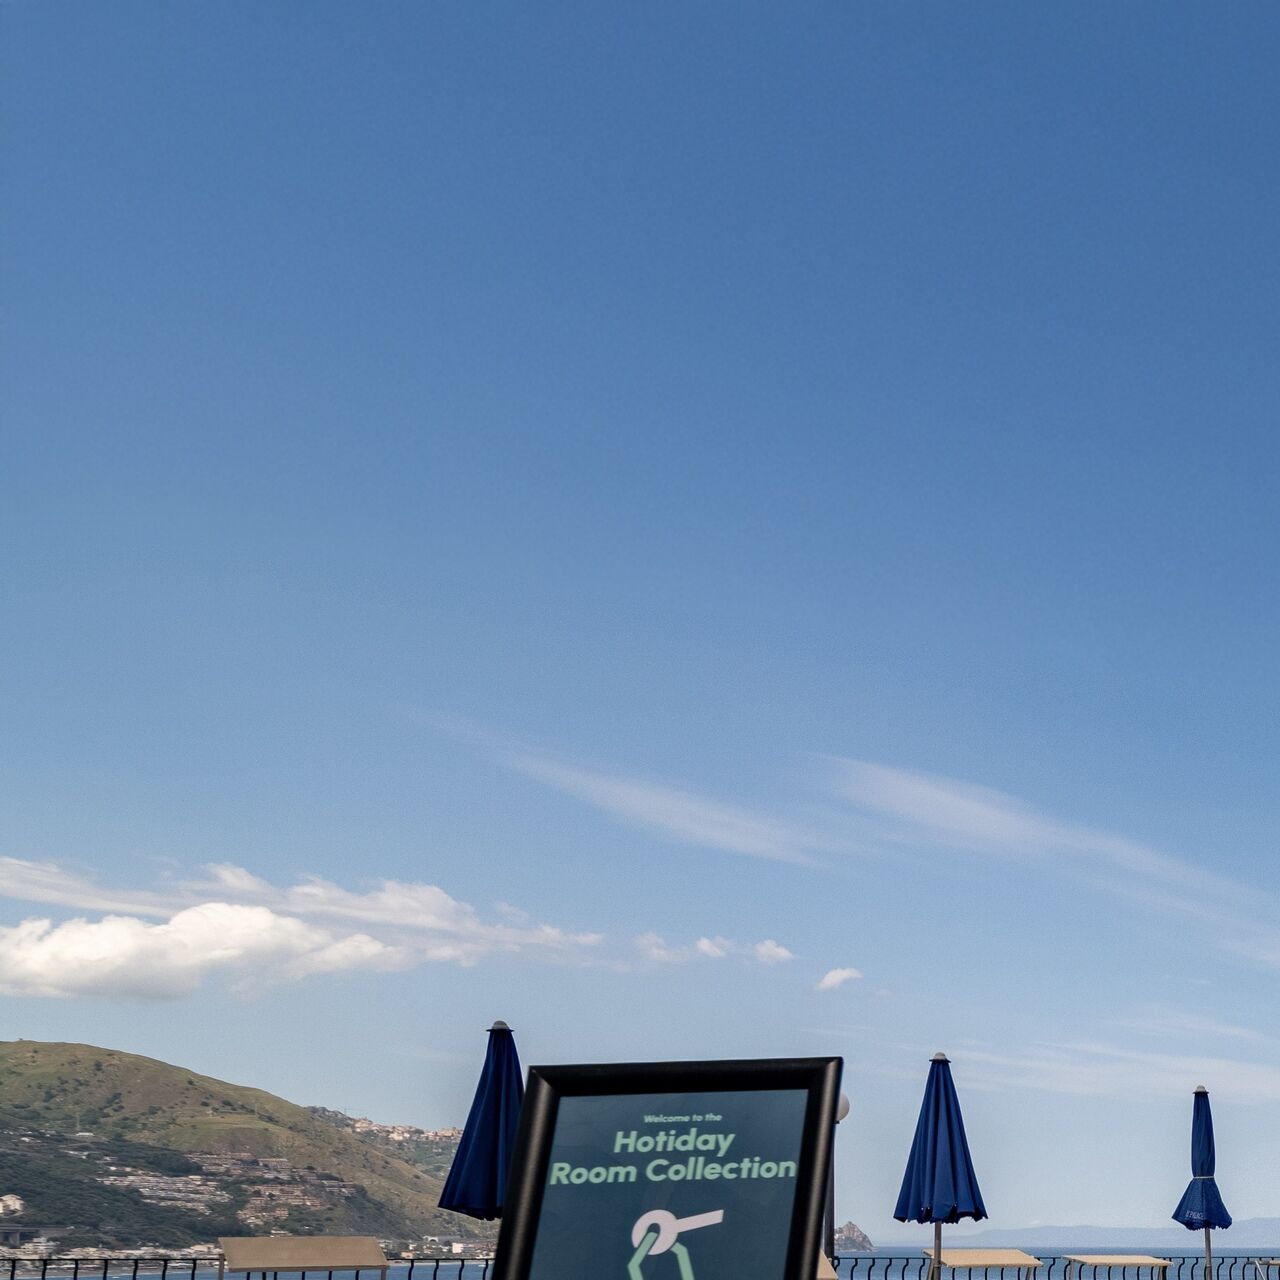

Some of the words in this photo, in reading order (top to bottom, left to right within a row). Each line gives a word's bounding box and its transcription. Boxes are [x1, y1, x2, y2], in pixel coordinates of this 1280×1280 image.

[644, 1114, 690, 1123] Welcome
[692, 1113, 703, 1122] to
[705, 1112, 723, 1121] the
[614, 1127, 735, 1156] Hotiday
[549, 1162, 638, 1185] Room
[645, 1156, 797, 1181] Collection
